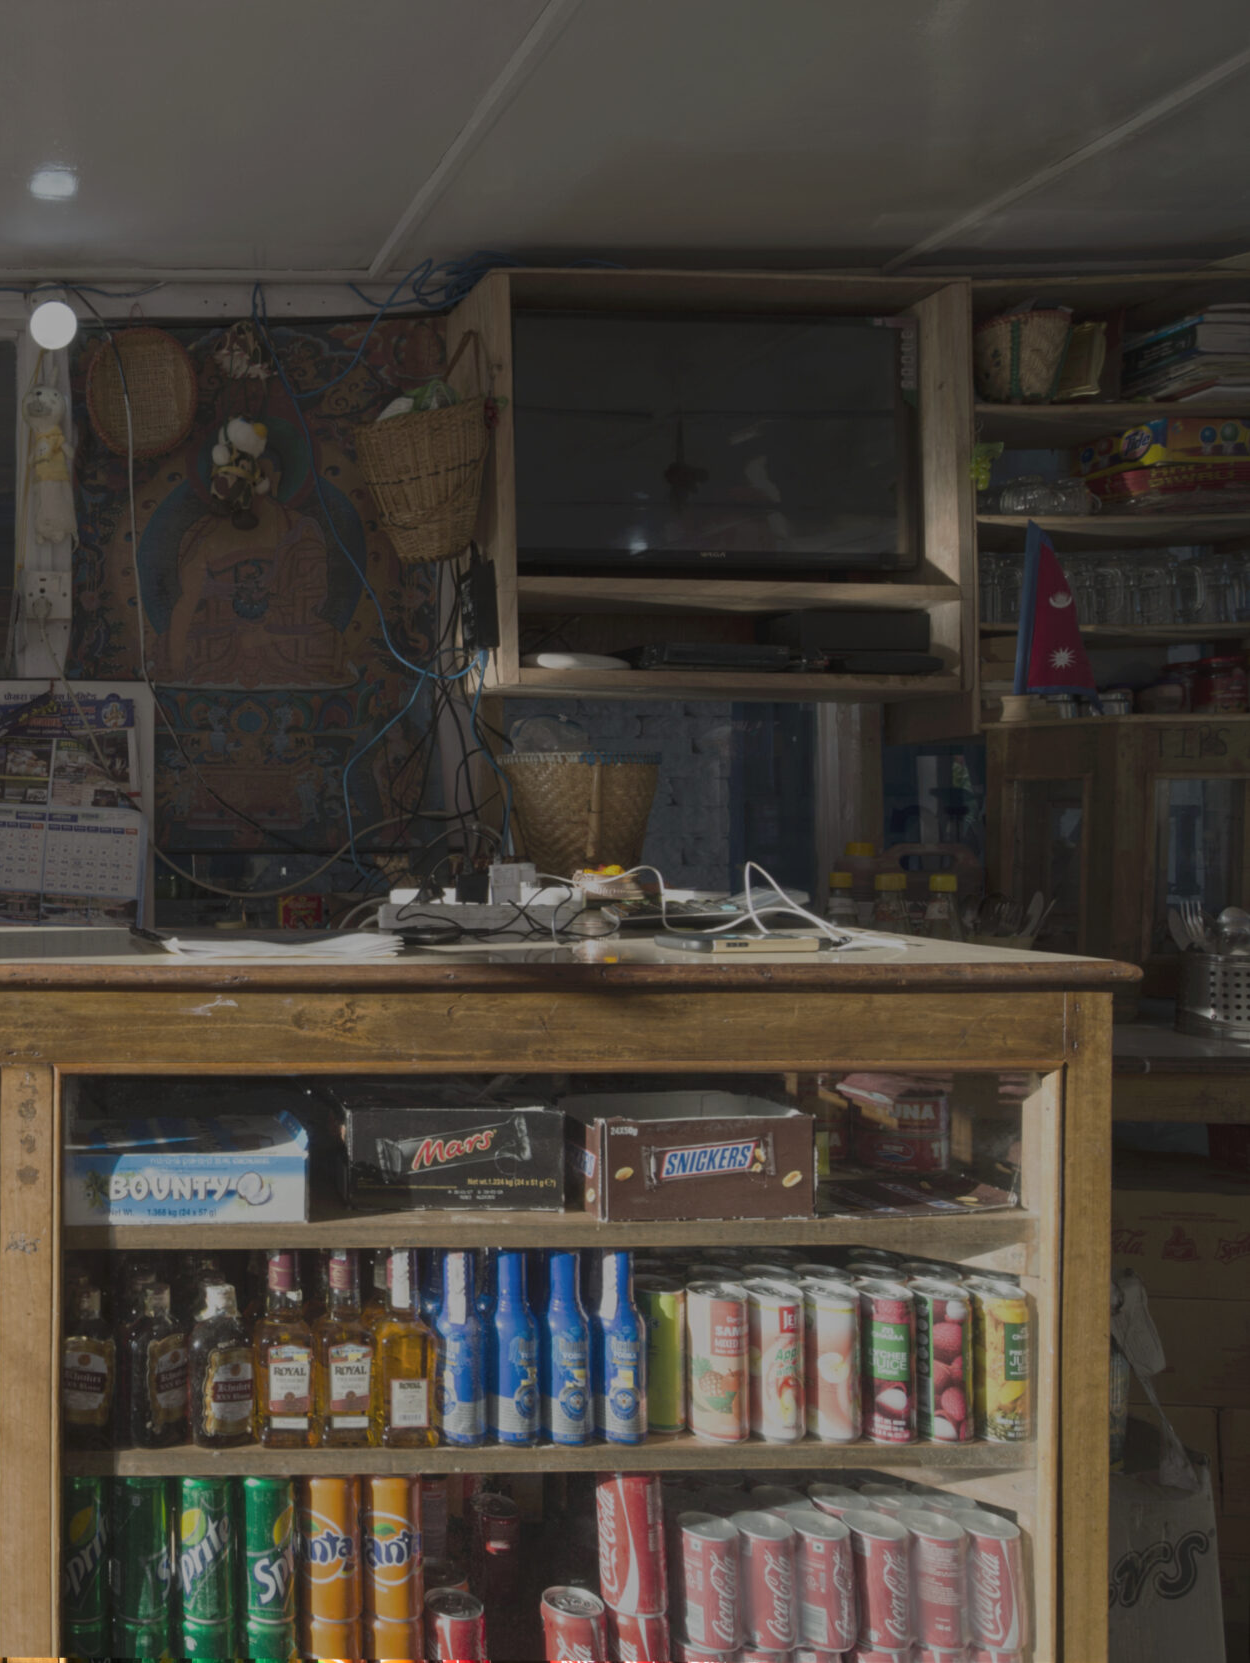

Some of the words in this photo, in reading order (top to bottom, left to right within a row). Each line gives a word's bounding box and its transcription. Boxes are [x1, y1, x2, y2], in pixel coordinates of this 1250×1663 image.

[1124, 432, 1151, 457] Tide
[1150, 724, 1230, 759] TIPS
[889, 1103, 936, 1121] UNA
[411, 1129, 493, 1170] Mars
[665, 1143, 752, 1176] SNICKERS
[109, 1175, 230, 1202] BOUNTY
[274, 1366, 307, 1376] ROYAL
[334, 1365, 367, 1376] ROYAL
[870, 1357, 909, 1371] JUICE
